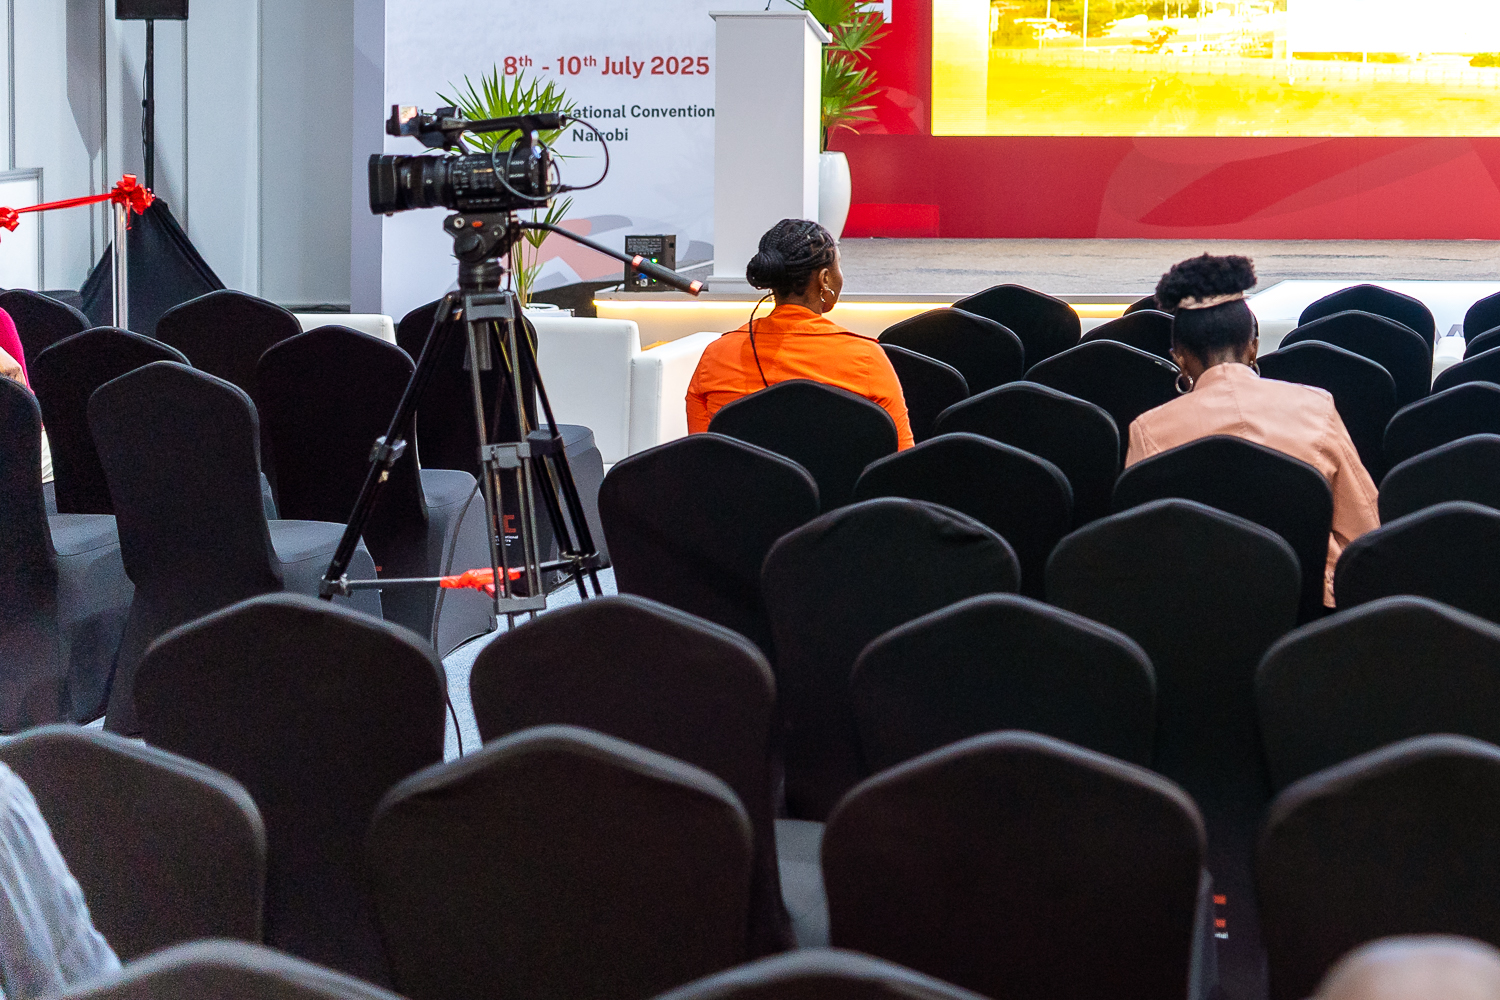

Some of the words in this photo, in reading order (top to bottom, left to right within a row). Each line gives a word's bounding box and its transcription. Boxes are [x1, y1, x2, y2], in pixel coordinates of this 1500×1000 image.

[556, 55, 597, 76] 10th
[601, 57, 644, 79] July
[651, 55, 710, 76] 2025
[631, 104, 715, 119] Convention
[572, 128, 628, 143] Nairobi
